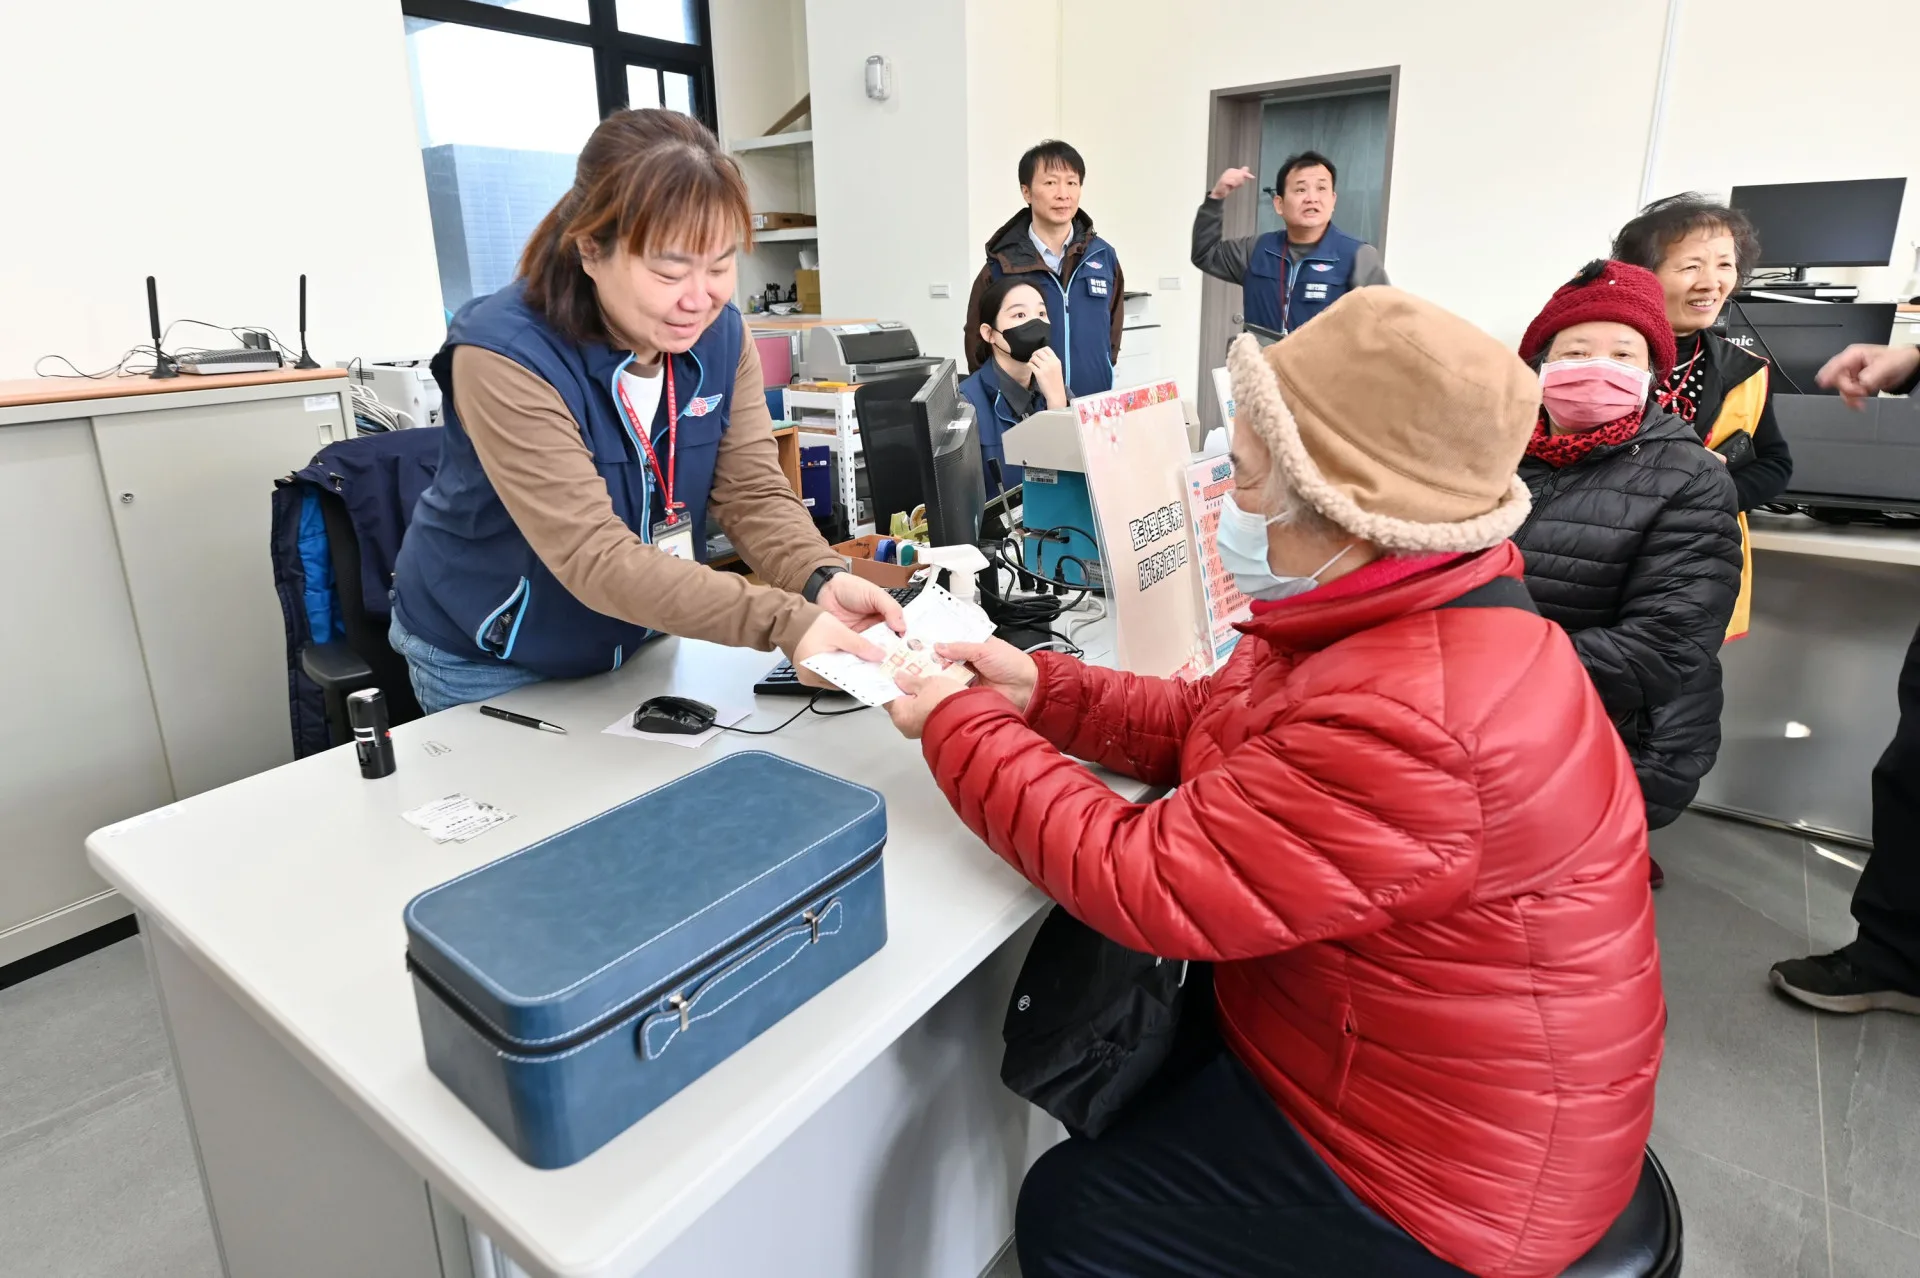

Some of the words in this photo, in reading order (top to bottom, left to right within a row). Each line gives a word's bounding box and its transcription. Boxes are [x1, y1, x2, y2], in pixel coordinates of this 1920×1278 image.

[1129, 501, 1184, 551] 監理業務
[1138, 540, 1187, 592] 服務窗口
